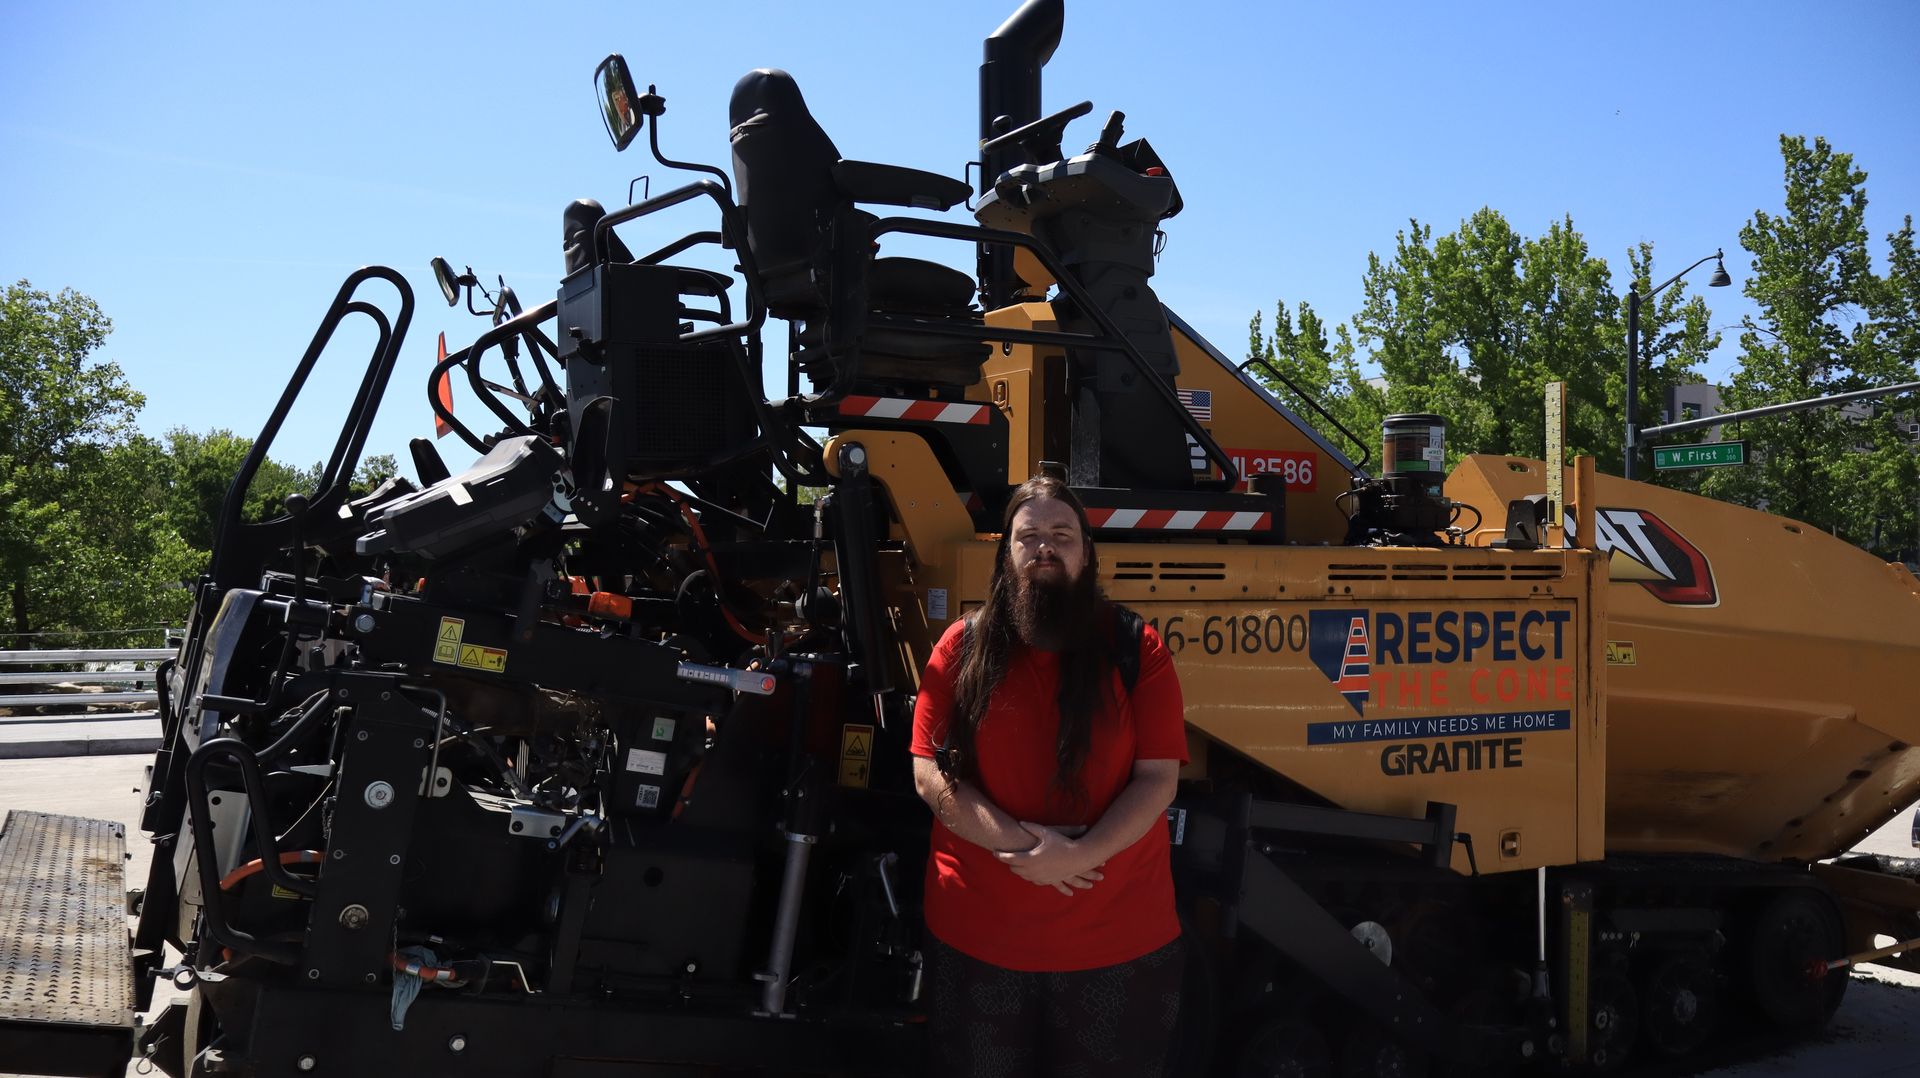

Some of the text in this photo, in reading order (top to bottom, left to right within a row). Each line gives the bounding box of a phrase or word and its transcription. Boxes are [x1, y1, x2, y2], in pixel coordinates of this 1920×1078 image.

[1672, 450, 1717, 462] W. First
[1376, 610, 1571, 665] RESPECT
[1371, 665, 1574, 709] THE CONE
[1333, 713, 1556, 739] MY FAMILY NEEDS ME HOME
[1380, 737, 1523, 777] GRANITE
